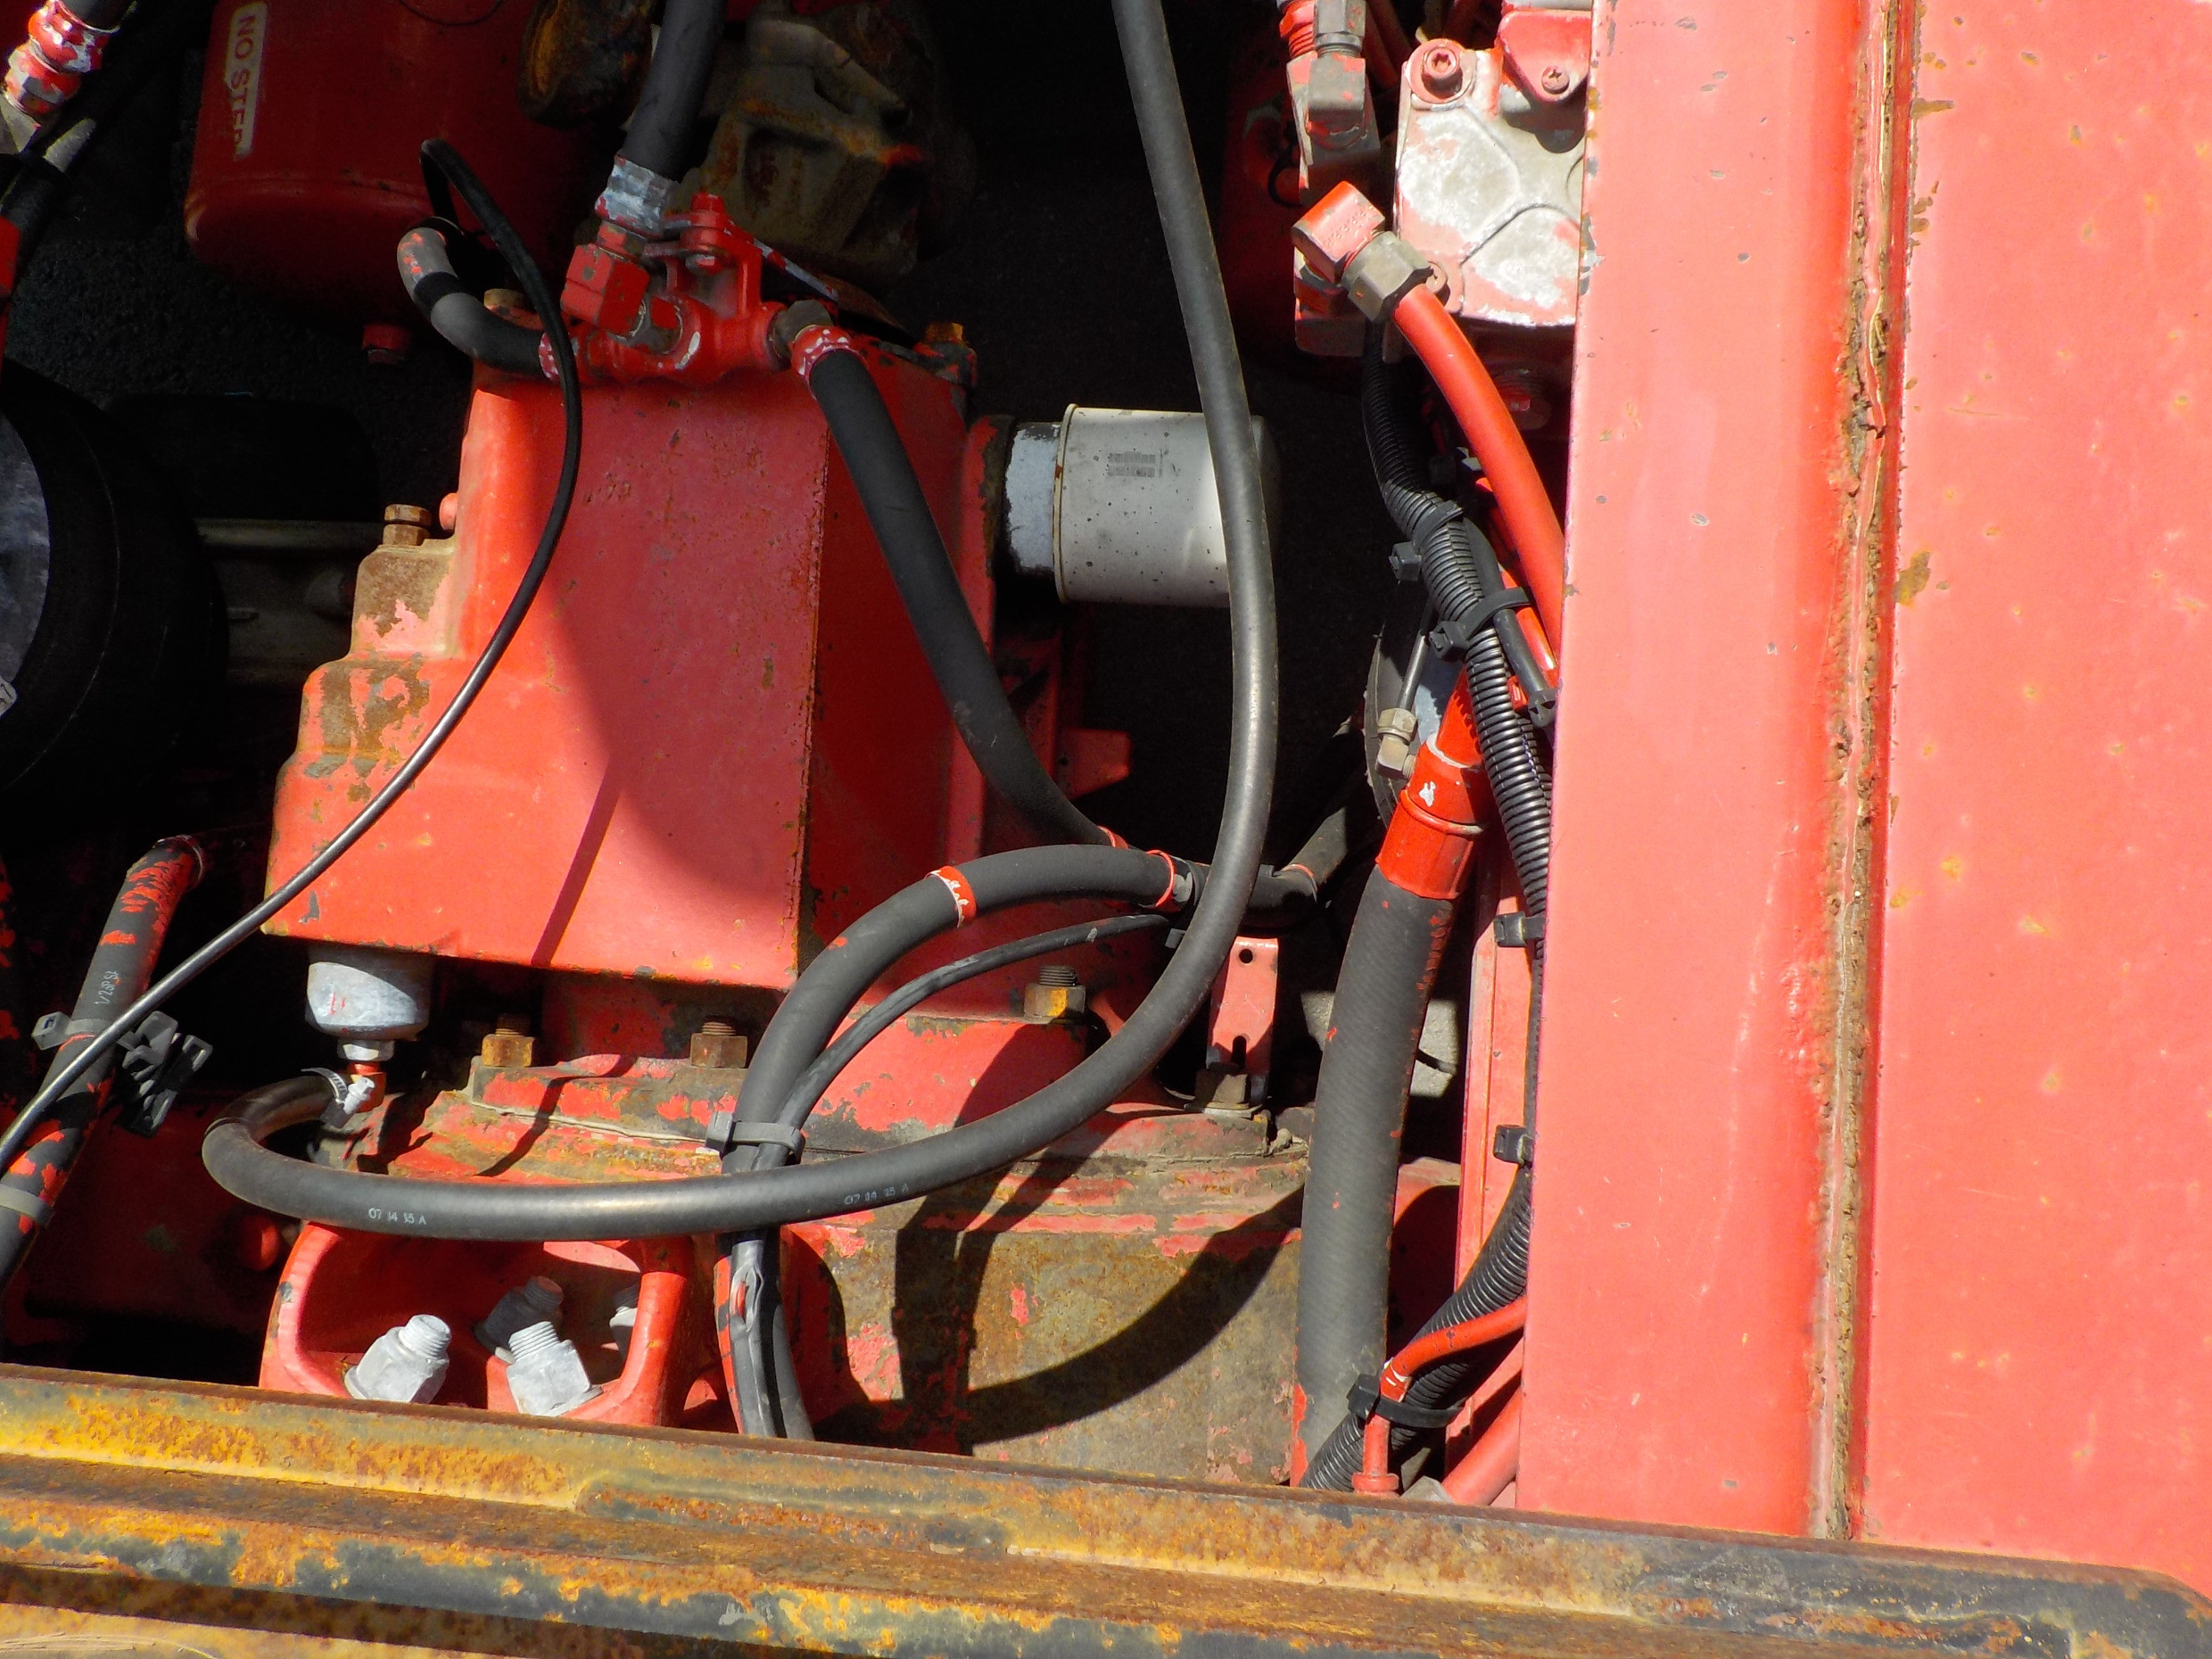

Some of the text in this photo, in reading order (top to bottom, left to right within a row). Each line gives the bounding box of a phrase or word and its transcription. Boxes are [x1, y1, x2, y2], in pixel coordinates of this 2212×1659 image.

[233, 12, 257, 60] NO
[367, 1207, 382, 1220] 07
[387, 1210, 399, 1222] 14
[418, 1214, 427, 1226] A
